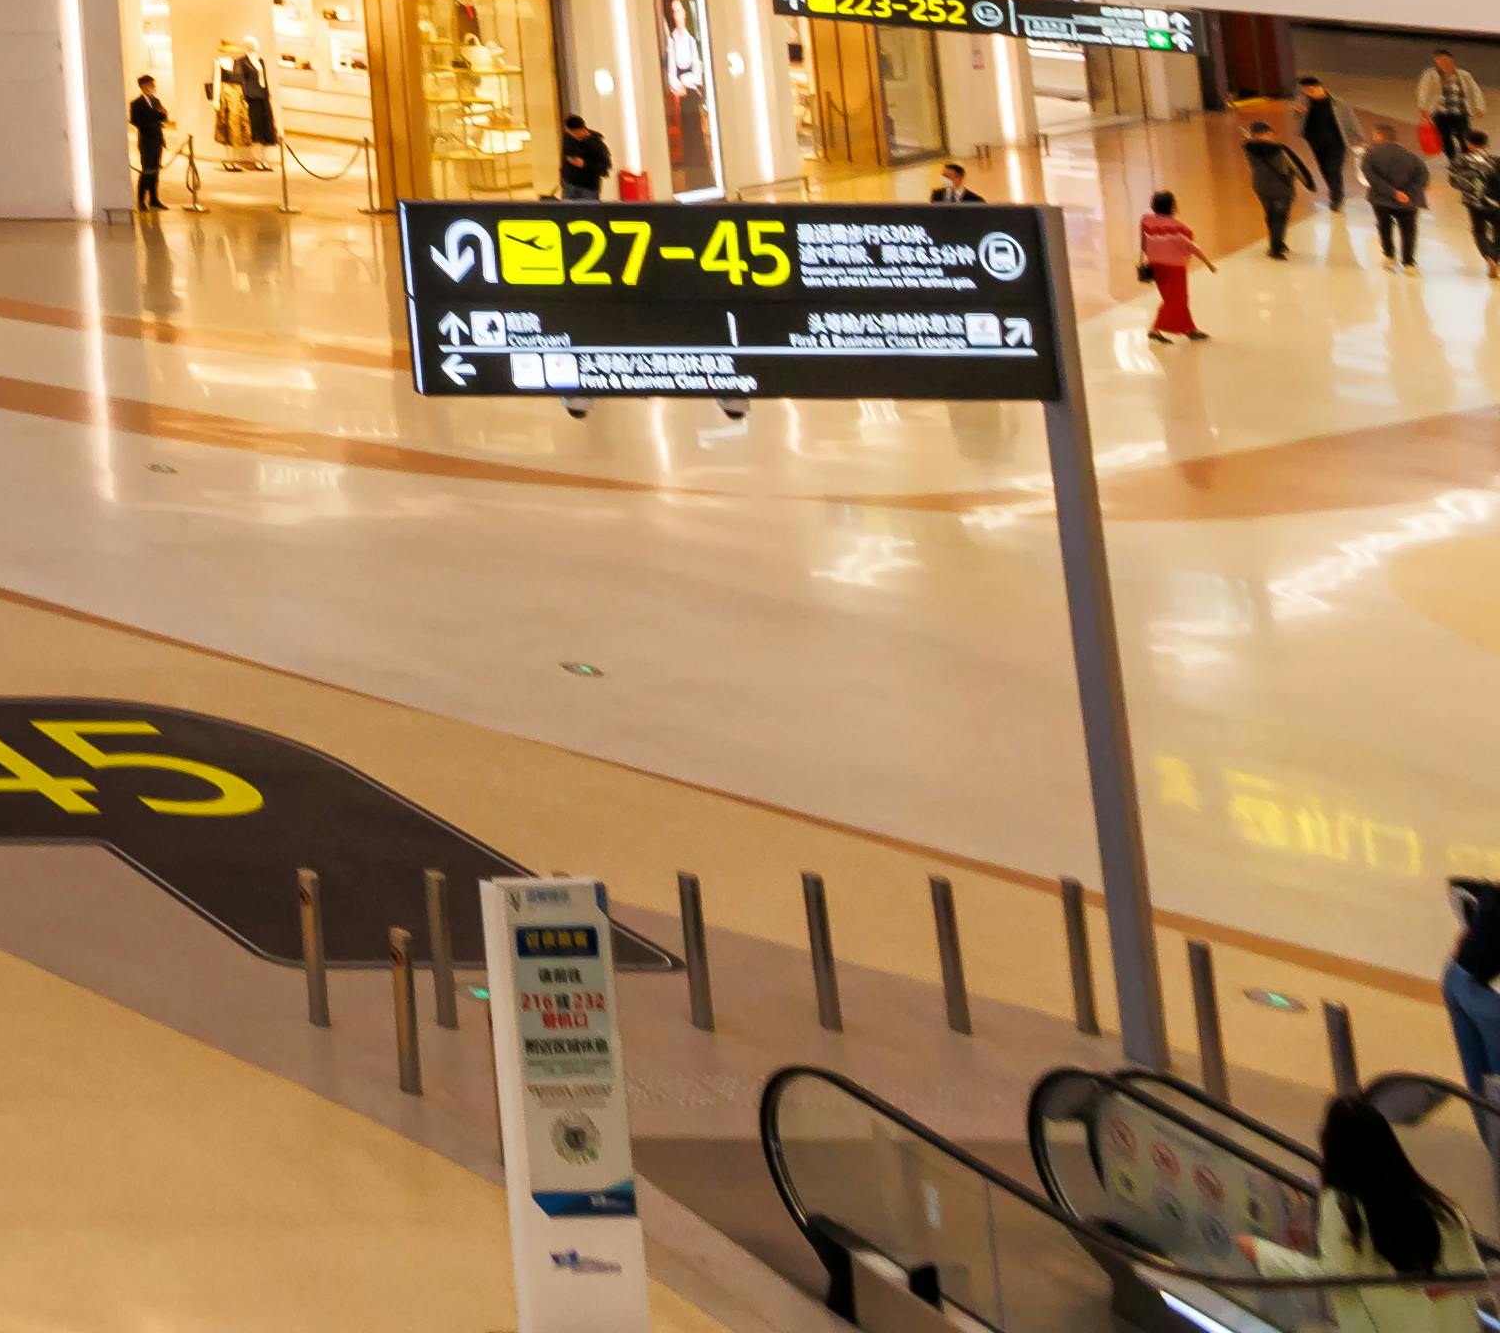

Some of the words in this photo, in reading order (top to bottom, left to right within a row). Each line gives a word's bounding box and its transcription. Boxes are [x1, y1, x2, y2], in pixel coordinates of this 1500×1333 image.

[568, 219, 792, 287] 27-45
[580, 373, 609, 389] First
[622, 374, 675, 390] Business
[677, 375, 705, 390] Class
[706, 376, 758, 392] Lounge
